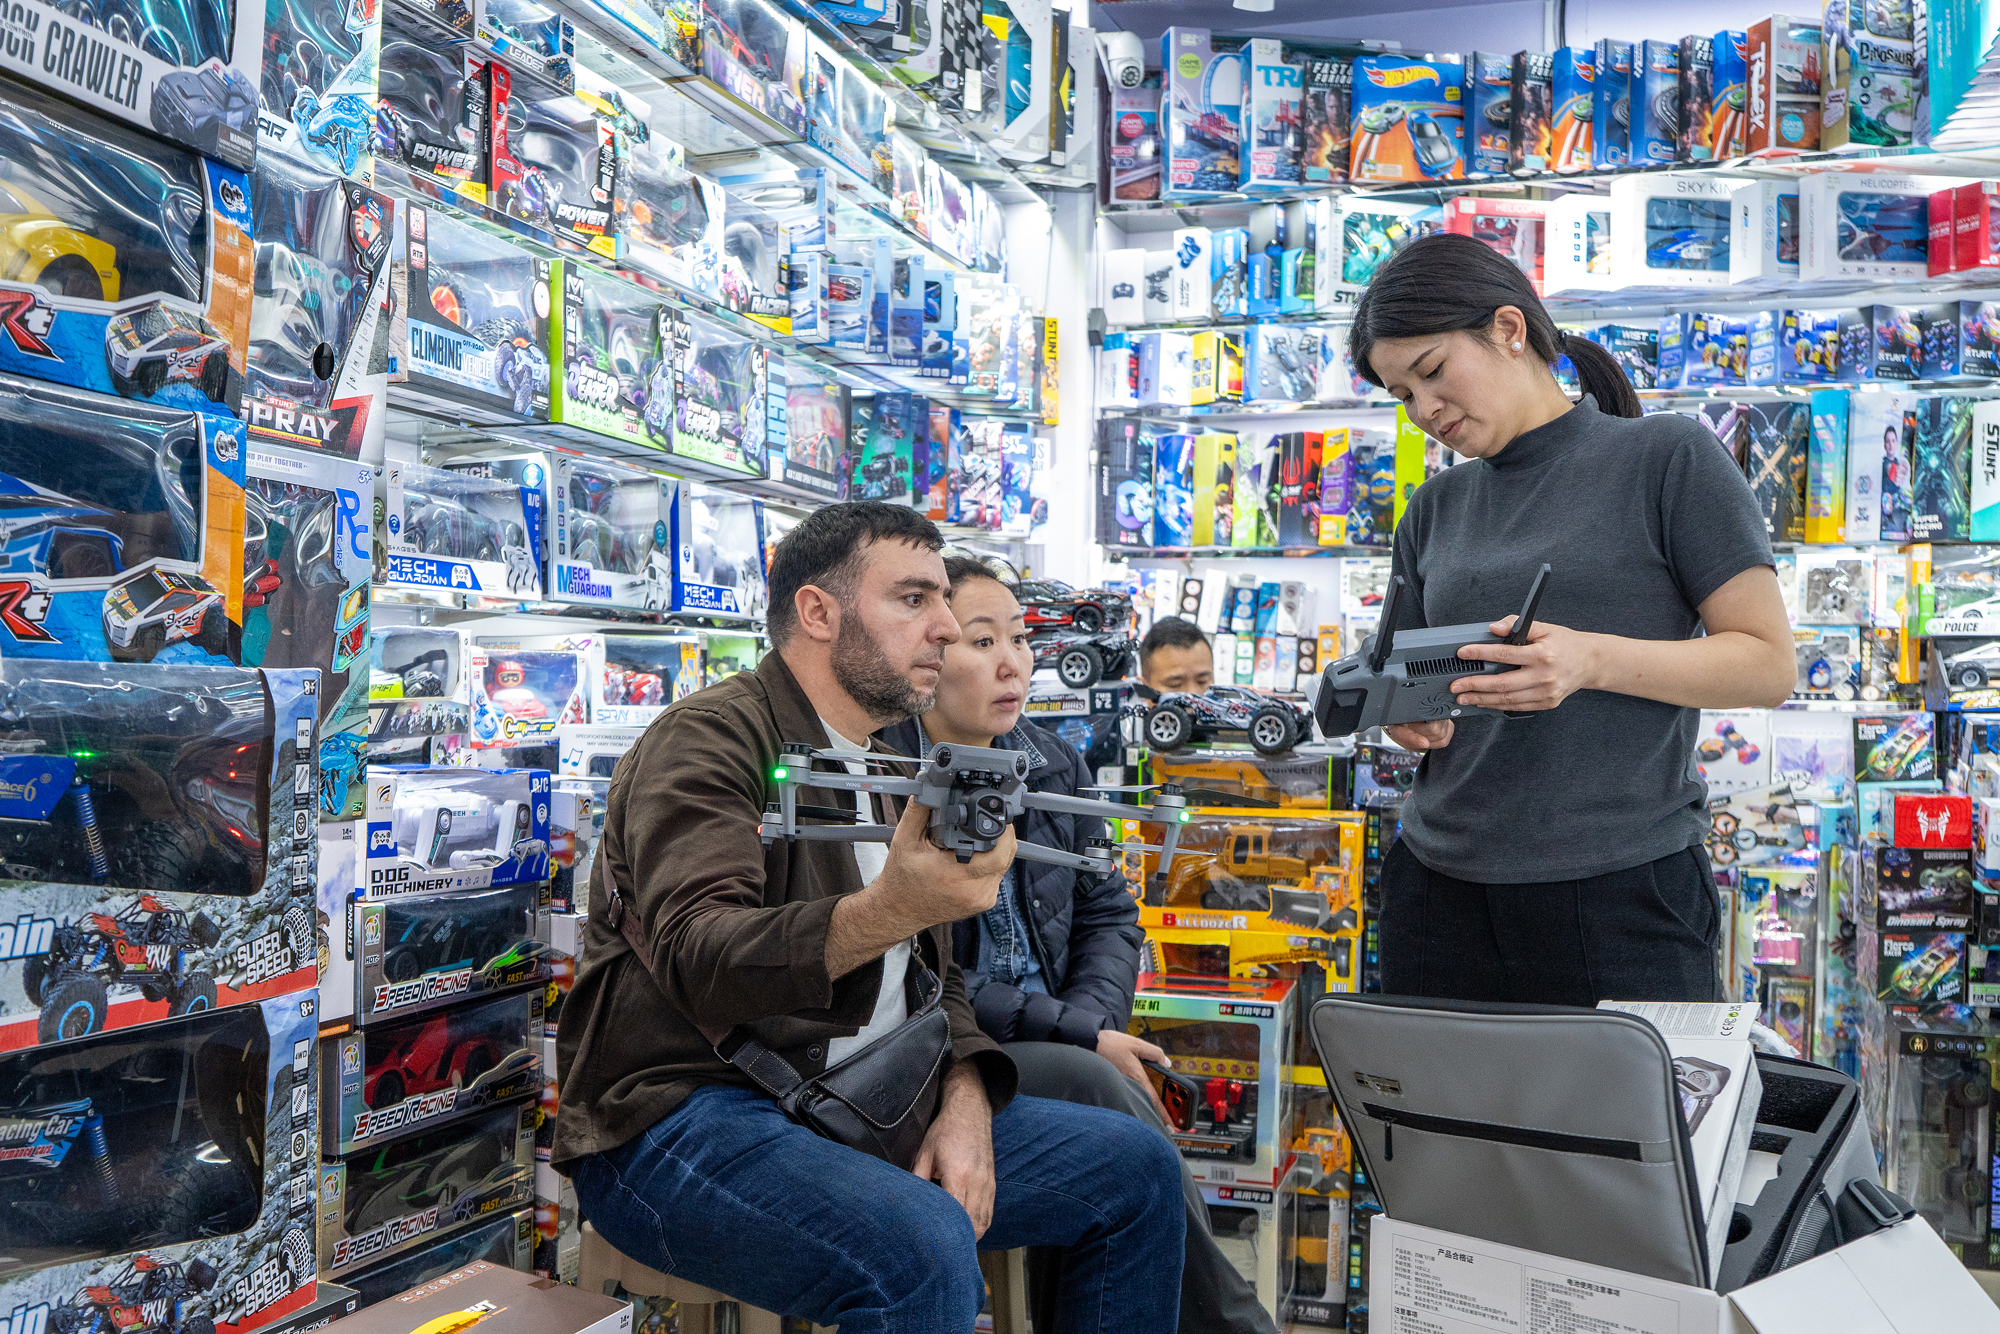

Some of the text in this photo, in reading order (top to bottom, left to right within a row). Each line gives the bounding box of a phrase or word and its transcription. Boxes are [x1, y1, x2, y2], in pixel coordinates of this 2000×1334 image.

[509, 45, 545, 72] LEADER
[1859, 42, 1914, 68] DINOSAUR
[42, 20, 143, 112] CRAWLER
[1313, 62, 1342, 74] FAST
[466, 103, 482, 115] 4X4
[411, 142, 478, 171] POWER
[433, 163, 473, 181] RACER
[1676, 181, 1706, 194] SKY
[1860, 178, 1916, 190] HELICOPTER
[555, 203, 610, 227] POWER
[573, 221, 605, 236] RACER
[411, 249, 424, 260] RTR
[659, 312, 673, 333] 6+
[411, 326, 463, 372] CLIMBING
[462, 339, 485, 352] OFF-ROAD
[1046, 321, 1058, 364] STUNT
[462, 352, 491, 381] VEHICLE
[568, 362, 620, 411] REAPER
[268, 397, 294, 408] STUNT
[623, 420, 639, 433] RTR
[1985, 422, 2000, 481] STUNT
[257, 454, 303, 469] PLAY TOGETHER
[527, 493, 540, 508] R/C
[388, 557, 437, 575] MECH
[388, 571, 447, 586] GUARDIAN
[557, 564, 590, 593] MECH
[568, 581, 612, 600] GUARDIAN
[684, 584, 715, 599] MECH
[684, 597, 721, 609] GUARDIAN
[1944, 622, 1979, 633] POLICE
[596, 709, 629, 722] SPRAY
[297, 729, 310, 738] 4WD
[24, 777, 38, 802] 6
[532, 777, 549, 793] R/C
[371, 867, 410, 884] DOG
[371, 878, 453, 897] MACHINERY
[1886, 917, 1969, 928] Dinosaur Spray
[237, 934, 282, 968] SUPER
[1884, 939, 1915, 951] Fierce
[146, 944, 173, 970] 4X4
[246, 948, 291, 985] SPEED
[507, 971, 523, 985] FAST
[375, 983, 423, 1012] SPEED
[424, 972, 471, 1000] RACING
[300, 1001, 314, 1018] 8+
[531, 1021, 542, 1030] MAX
[294, 1049, 309, 1064] 4WD
[344, 1084, 356, 1093] HOT
[496, 1084, 514, 1099] FAST
[353, 1091, 457, 1140] SPEED RACING
[44, 1114, 74, 1138] Car
[520, 1131, 533, 1141] MAX
[480, 1197, 499, 1215] FAST
[323, 1213, 336, 1223] HOT
[332, 1209, 438, 1267] SPEED RACING
[517, 1242, 531, 1252] MAX
[1329, 1222, 1340, 1283] EXCAVATOR
[1437, 1248, 1474, 1265] 产品合格证
[235, 1264, 280, 1302] SUPER
[1566, 1278, 1621, 1297] 电池使用注意事项
[244, 1273, 291, 1317] SPEED
[140, 1298, 168, 1323] 4X4
[620, 1314, 631, 1324] 14+
[1394, 1306, 1419, 1319] 注意事项
